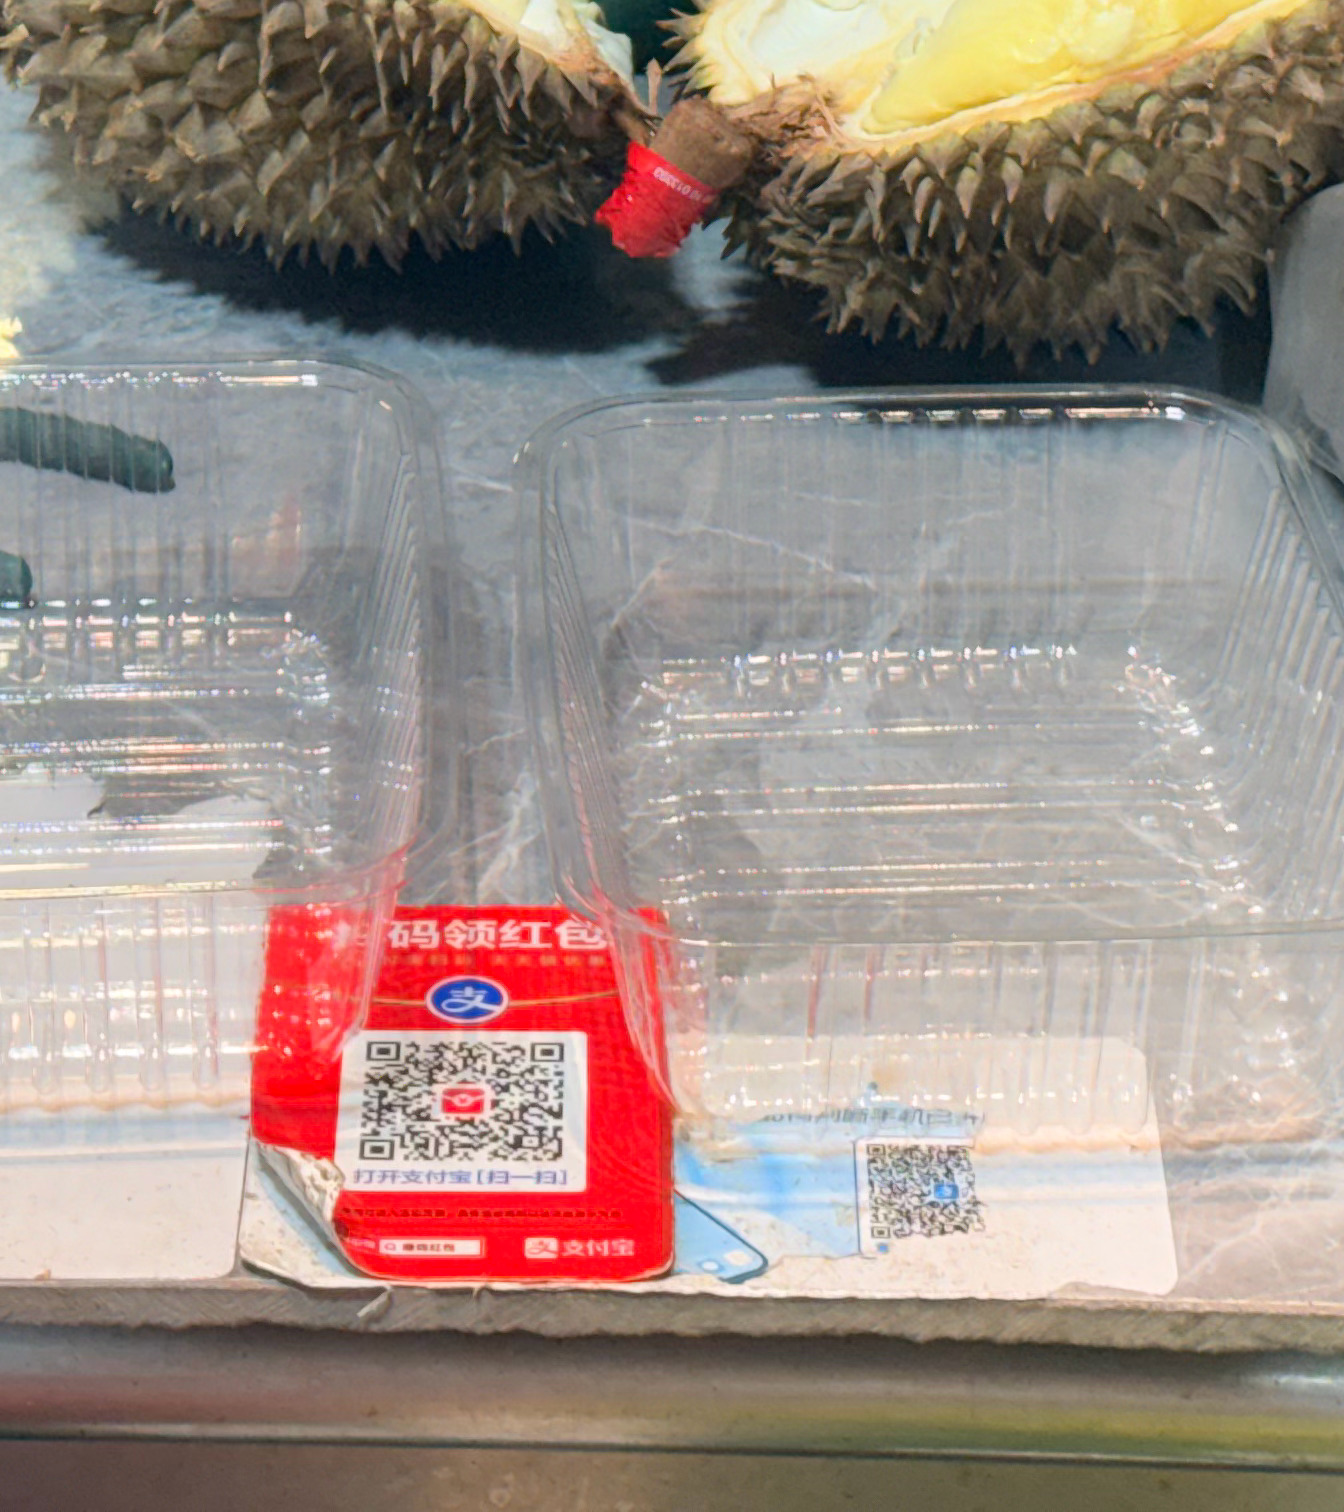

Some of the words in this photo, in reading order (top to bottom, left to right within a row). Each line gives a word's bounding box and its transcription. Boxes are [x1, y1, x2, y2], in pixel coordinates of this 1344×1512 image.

[332, 918, 608, 951] 码领红包
[561, 1239, 636, 1257] 支付宝
